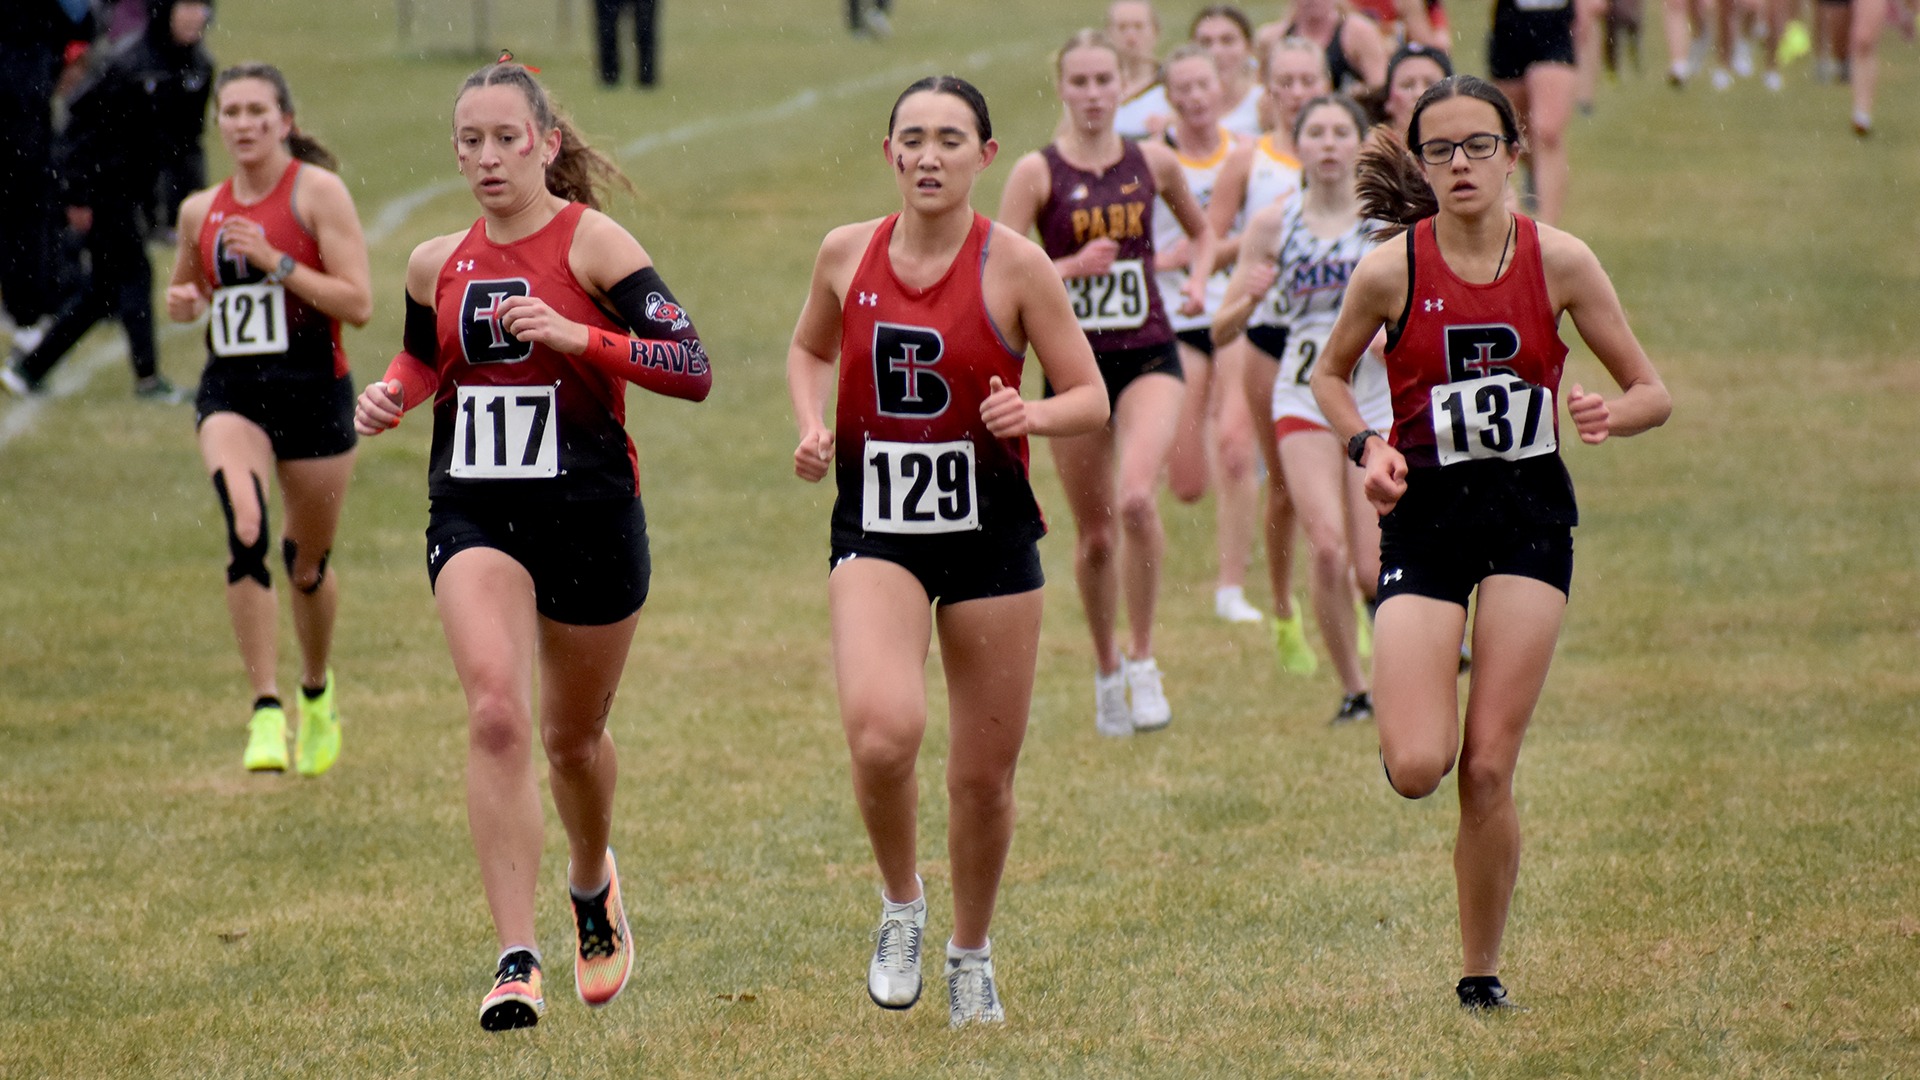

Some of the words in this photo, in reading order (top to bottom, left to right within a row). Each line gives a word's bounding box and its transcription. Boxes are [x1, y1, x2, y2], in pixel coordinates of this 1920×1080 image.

[1071, 202, 1145, 242] PARK
[218, 293, 276, 346] 121
[1072, 269, 1142, 319] 329
[872, 320, 951, 419] B
[462, 396, 551, 466] 117
[1441, 380, 1544, 453] 137
[869, 451, 971, 522] 129
